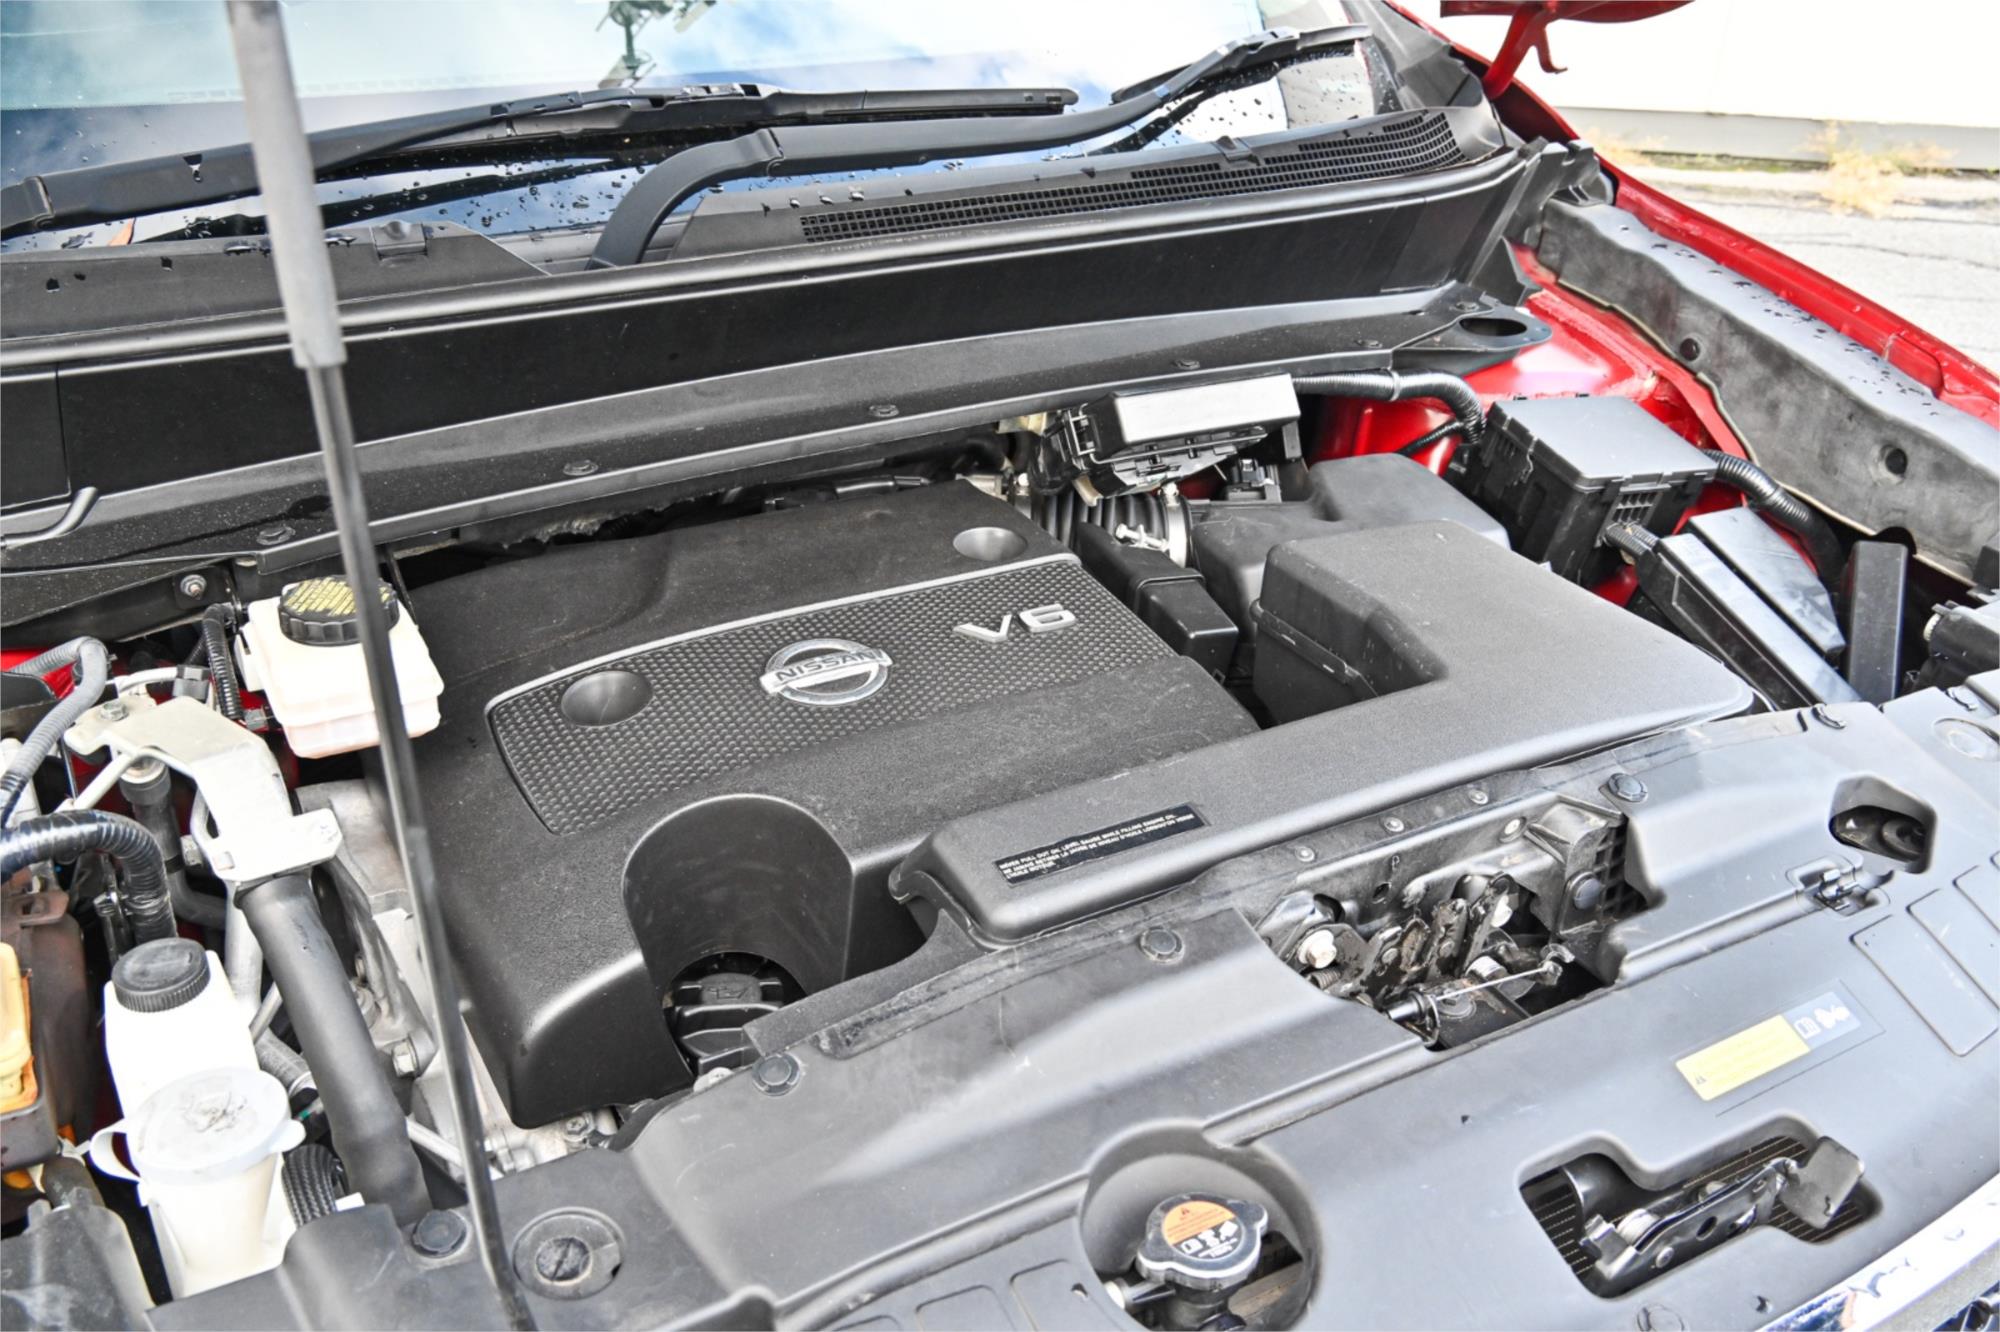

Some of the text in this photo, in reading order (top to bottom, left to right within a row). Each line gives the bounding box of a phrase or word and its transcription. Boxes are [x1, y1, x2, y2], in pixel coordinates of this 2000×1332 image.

[953, 603, 1076, 643] V6
[775, 650, 884, 681] NISSAN
[1020, 855, 1036, 864] PULL
[1036, 850, 1050, 858] OUT
[1120, 823, 1142, 833] FILLING
